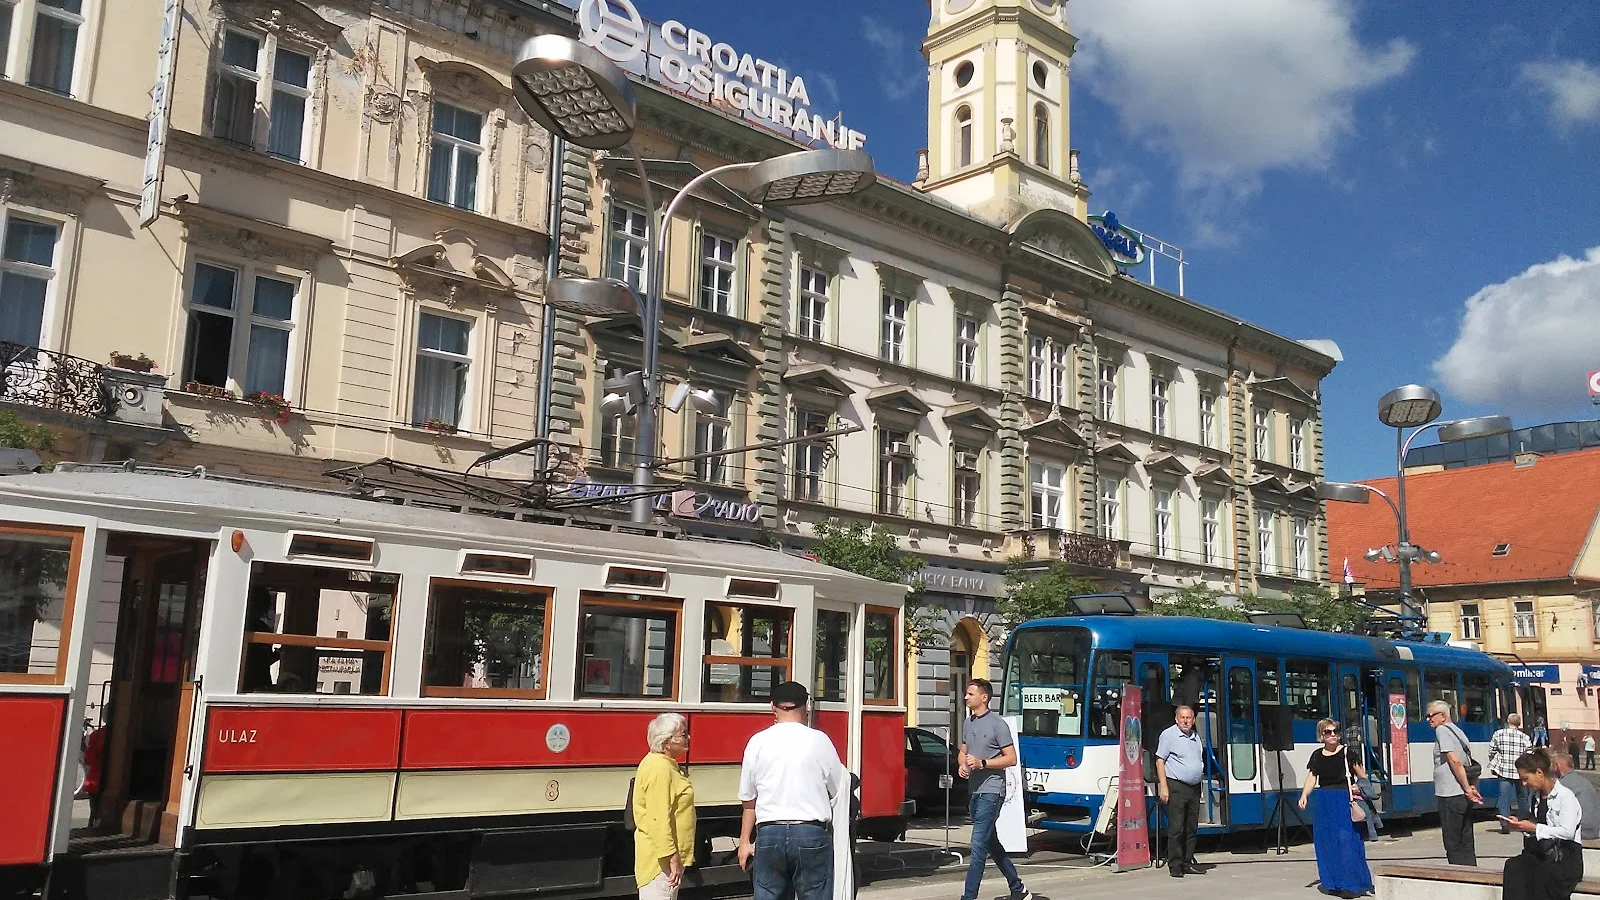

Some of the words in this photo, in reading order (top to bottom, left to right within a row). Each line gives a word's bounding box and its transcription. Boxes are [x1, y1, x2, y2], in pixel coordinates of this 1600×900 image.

[661, 19, 811, 106] CROATIA
[659, 54, 867, 151] OSIGURANJE
[710, 498, 760, 523] RADIO
[951, 575, 987, 593] BANKA
[1024, 693, 1043, 703] BEER
[1044, 693, 1061, 703] BAR
[1034, 715, 1040, 731] 1
[219, 729, 257, 743] ULAZ
[545, 779, 559, 801] 8
